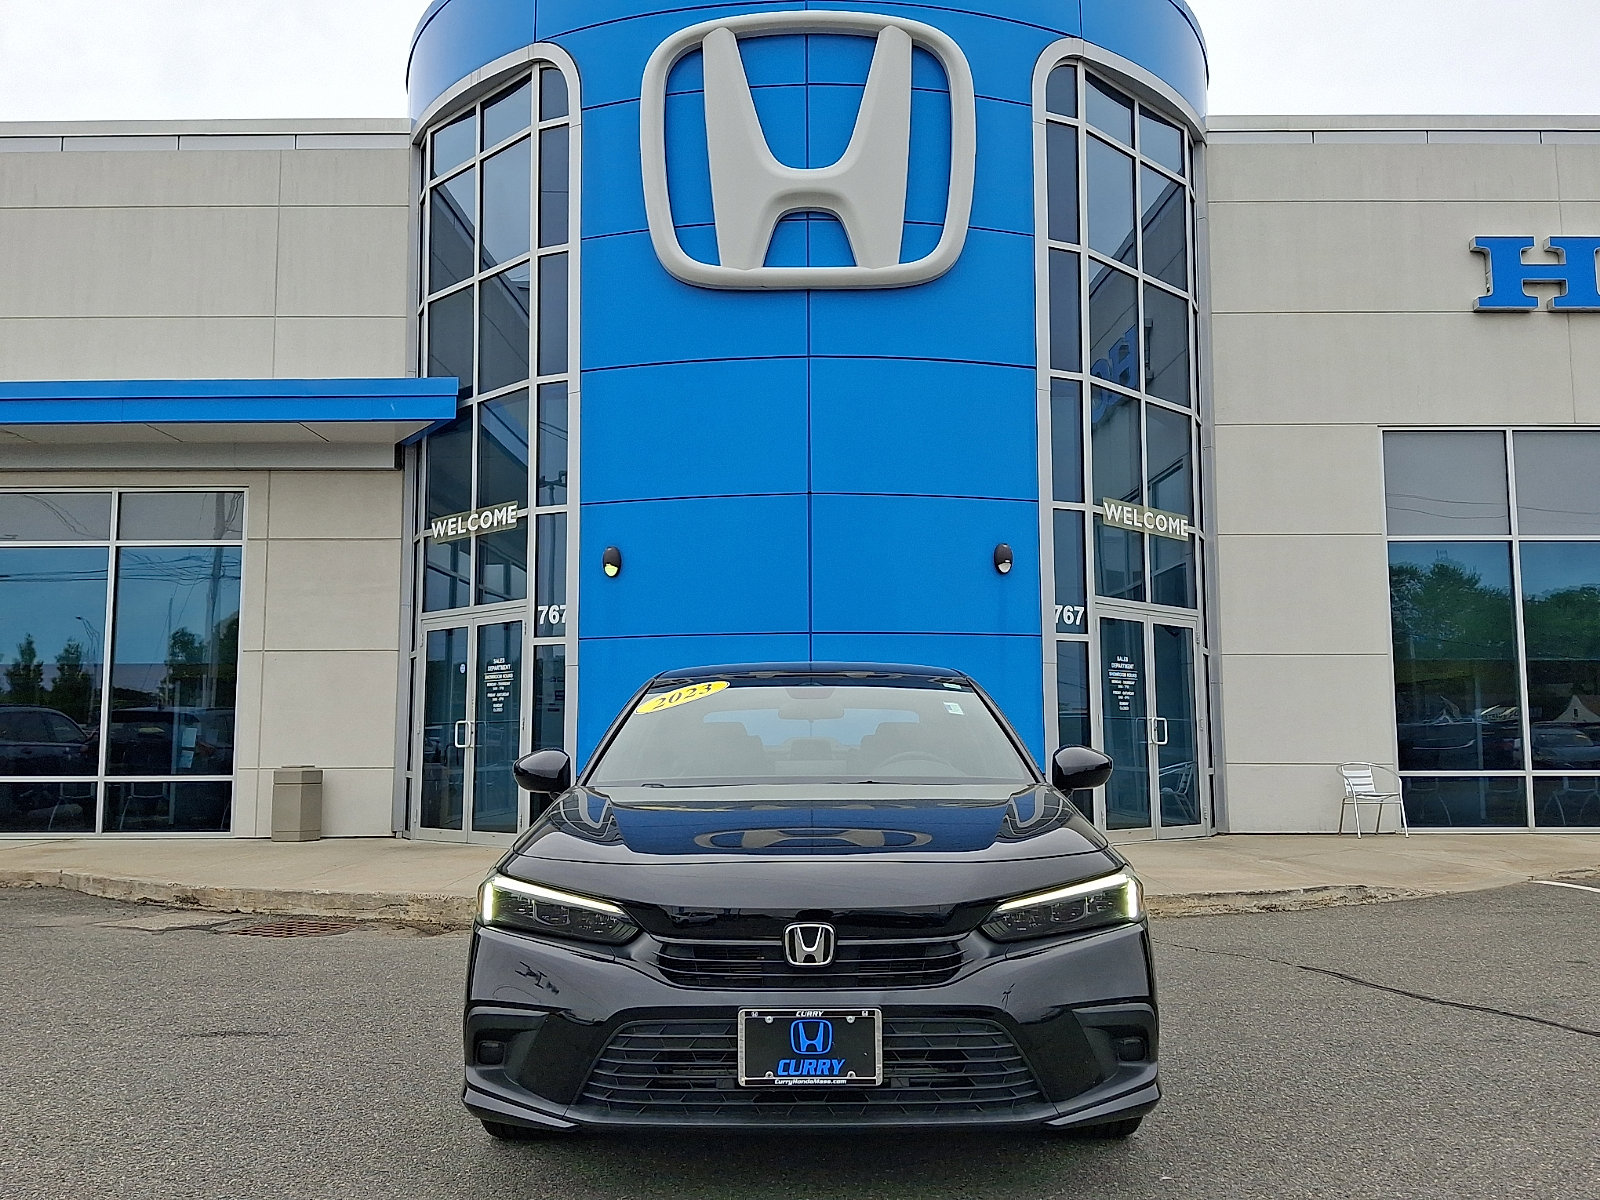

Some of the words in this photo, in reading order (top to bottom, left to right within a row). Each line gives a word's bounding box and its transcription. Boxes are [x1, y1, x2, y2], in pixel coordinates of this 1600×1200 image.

[431, 504, 518, 539] WELCOME
[1103, 501, 1189, 537] WELCOME
[537, 604, 567, 625] 767
[1054, 604, 1085, 625] 767
[653, 683, 712, 710] 2023
[795, 1010, 824, 1018] CURRY
[777, 1058, 846, 1076] CURRY
